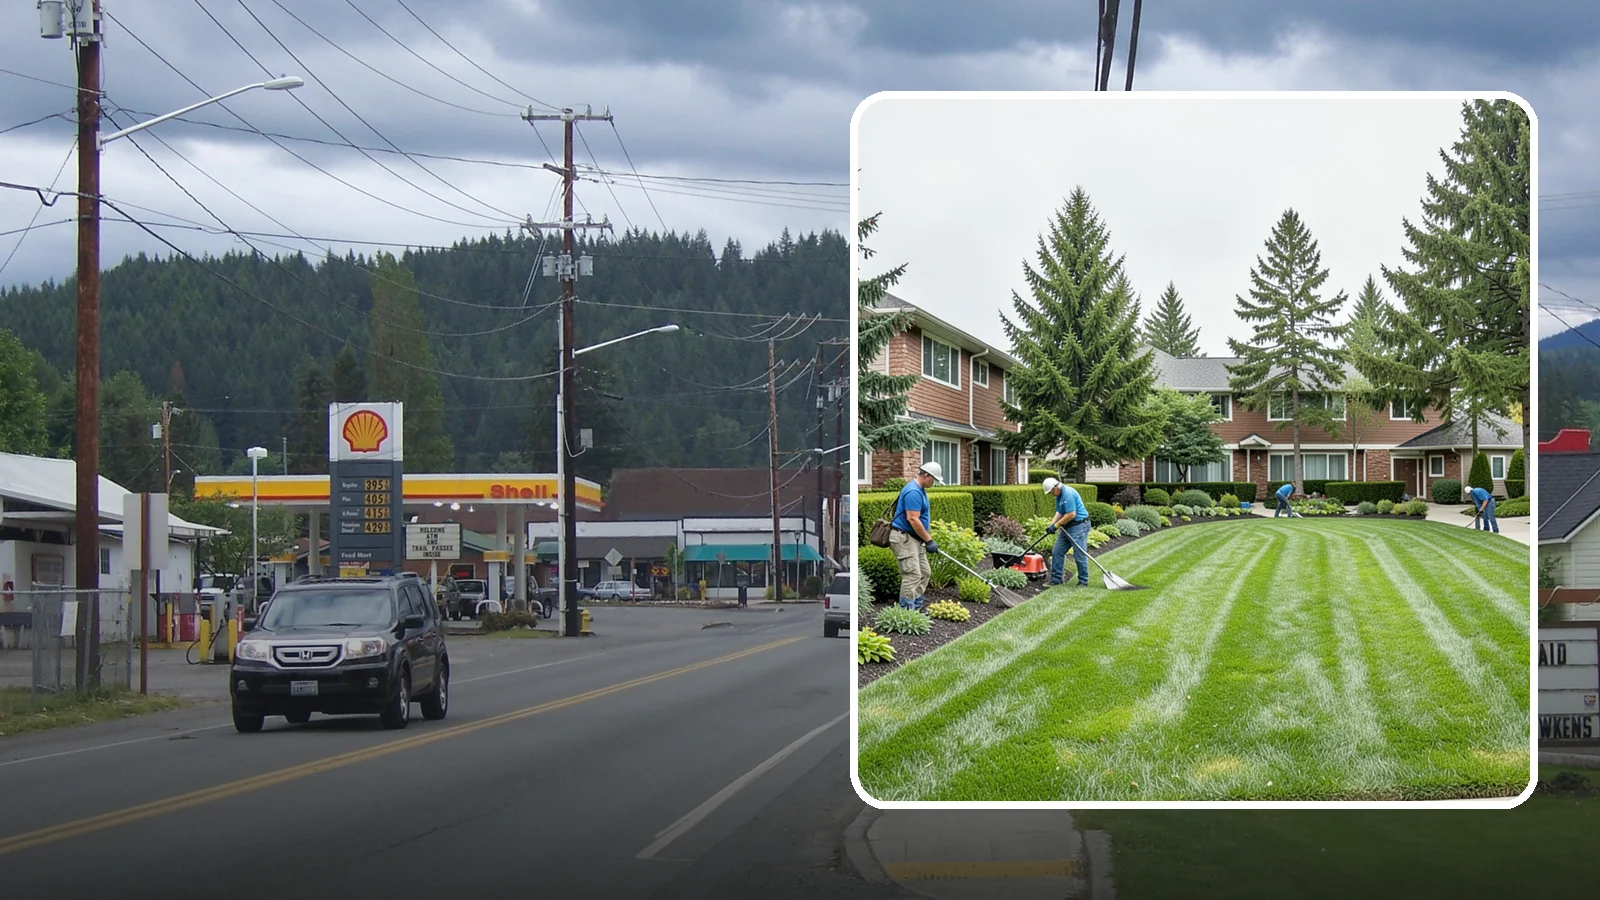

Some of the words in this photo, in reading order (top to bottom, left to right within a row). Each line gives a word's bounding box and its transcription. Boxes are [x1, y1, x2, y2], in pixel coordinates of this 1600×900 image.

[366, 480, 383, 490] 395
[490, 484, 547, 499] Shell
[365, 494, 383, 504] 405
[365, 508, 383, 518] 415
[365, 522, 383, 532] 429
